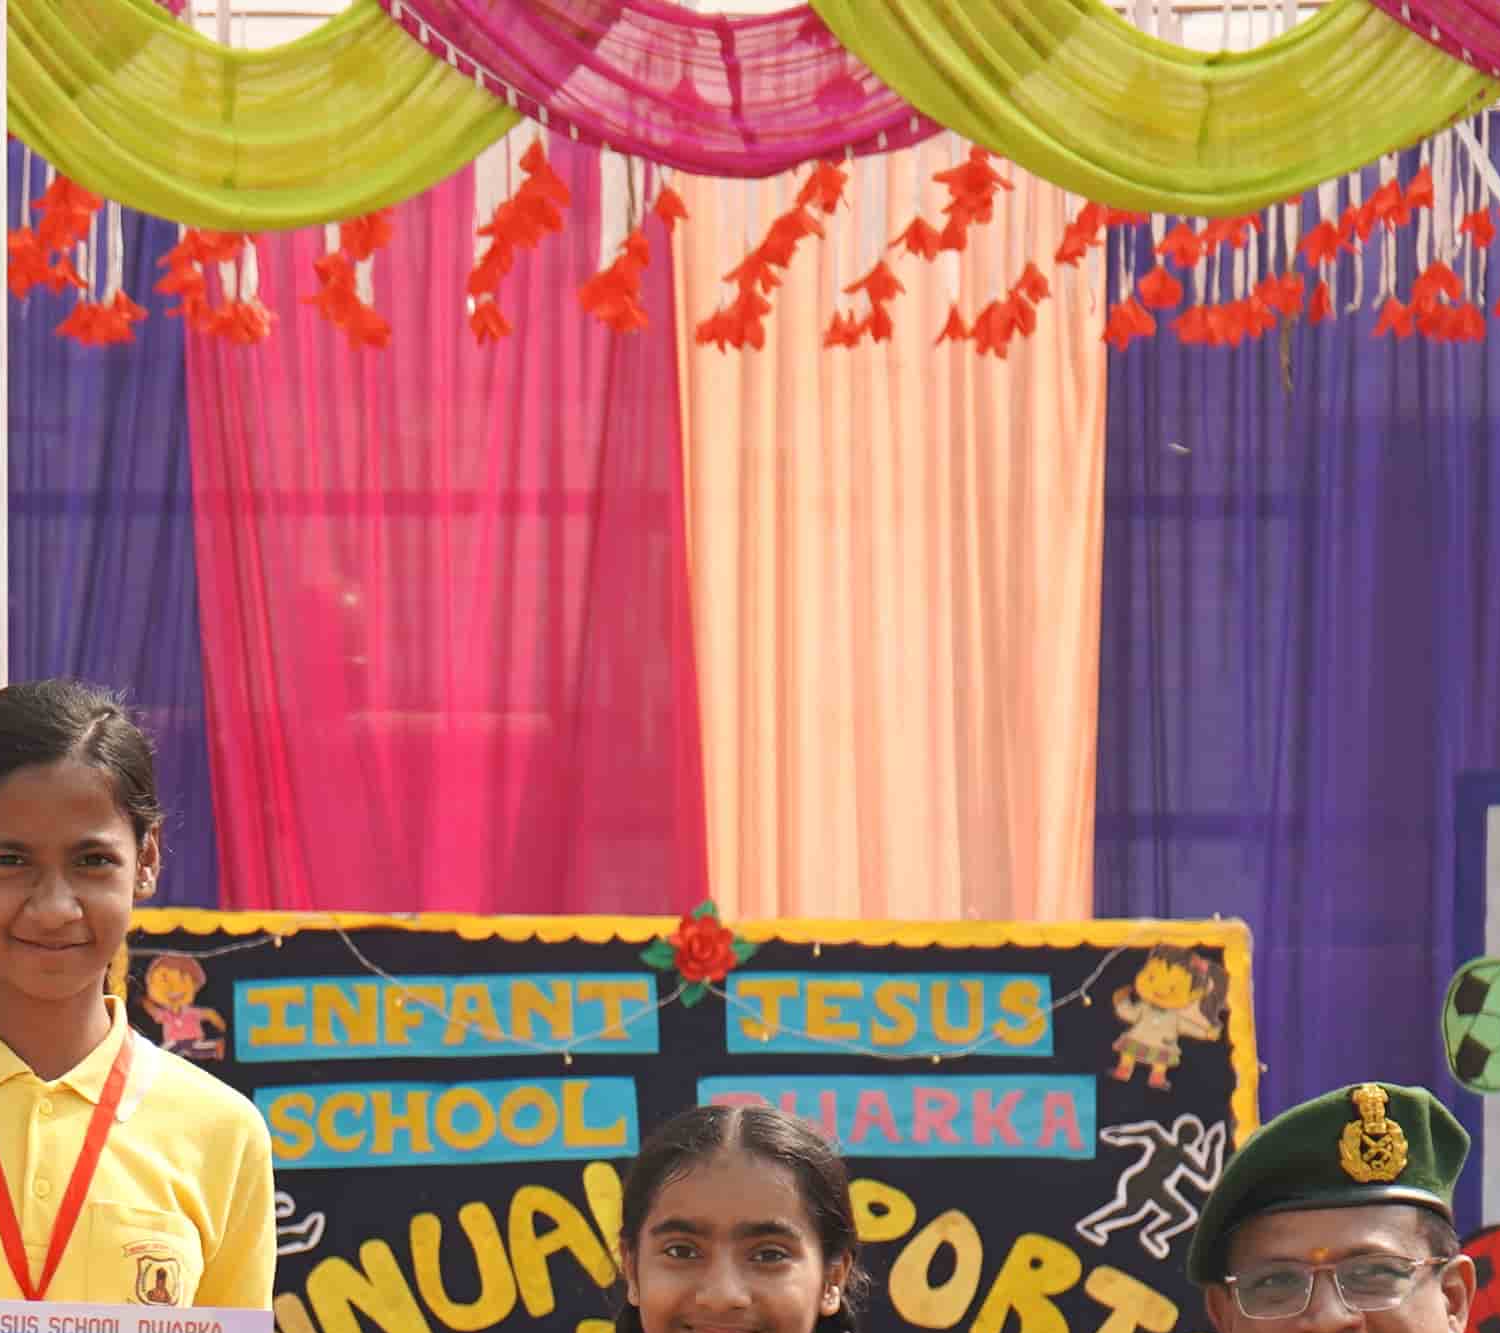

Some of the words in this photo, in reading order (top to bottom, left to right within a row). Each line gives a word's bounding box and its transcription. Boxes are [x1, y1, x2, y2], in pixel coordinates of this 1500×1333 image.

[247, 981, 649, 1049] INFANT
[738, 978, 1048, 1051] JESUS
[269, 1079, 627, 1161] SCHOOL
[711, 1087, 1085, 1151] ARKA
